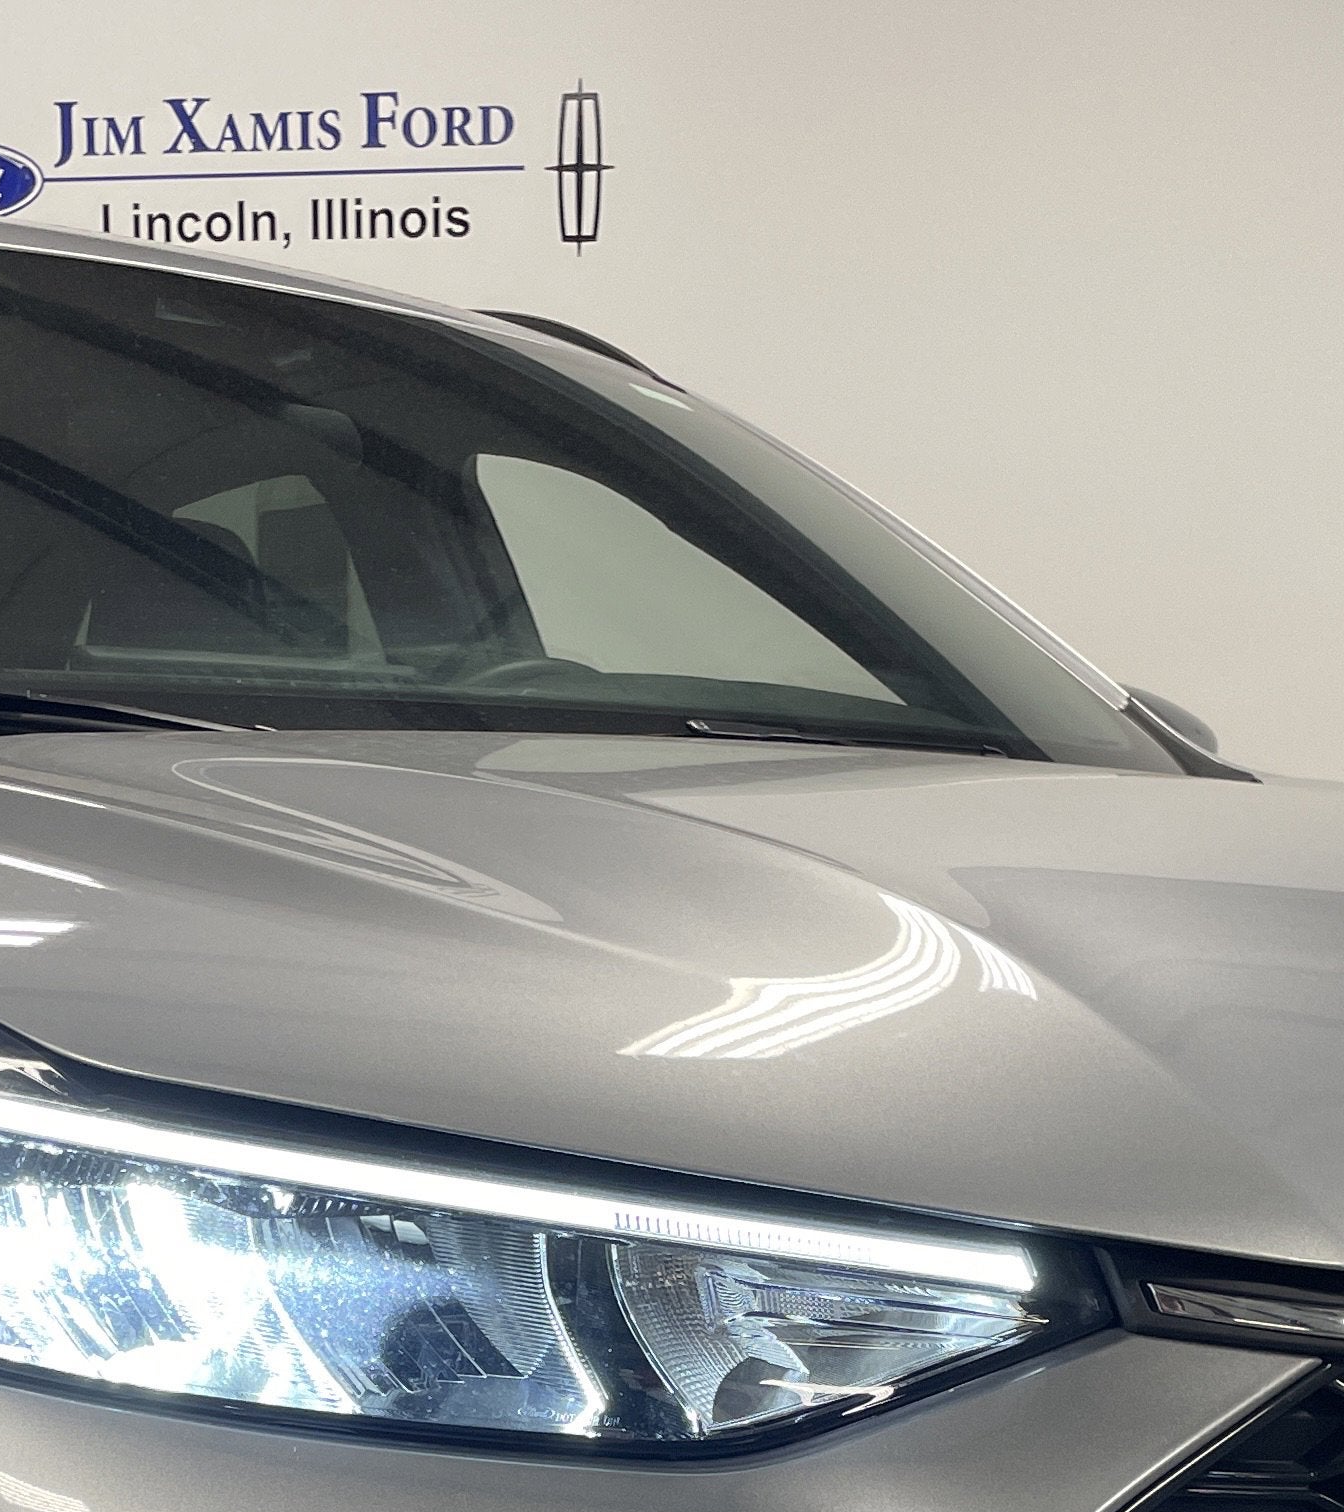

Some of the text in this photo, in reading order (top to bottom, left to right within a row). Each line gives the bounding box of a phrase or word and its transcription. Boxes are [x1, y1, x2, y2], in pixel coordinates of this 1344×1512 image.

[53, 92, 513, 168] JIM XAMIS FORD
[312, 196, 470, 240] Illinois
